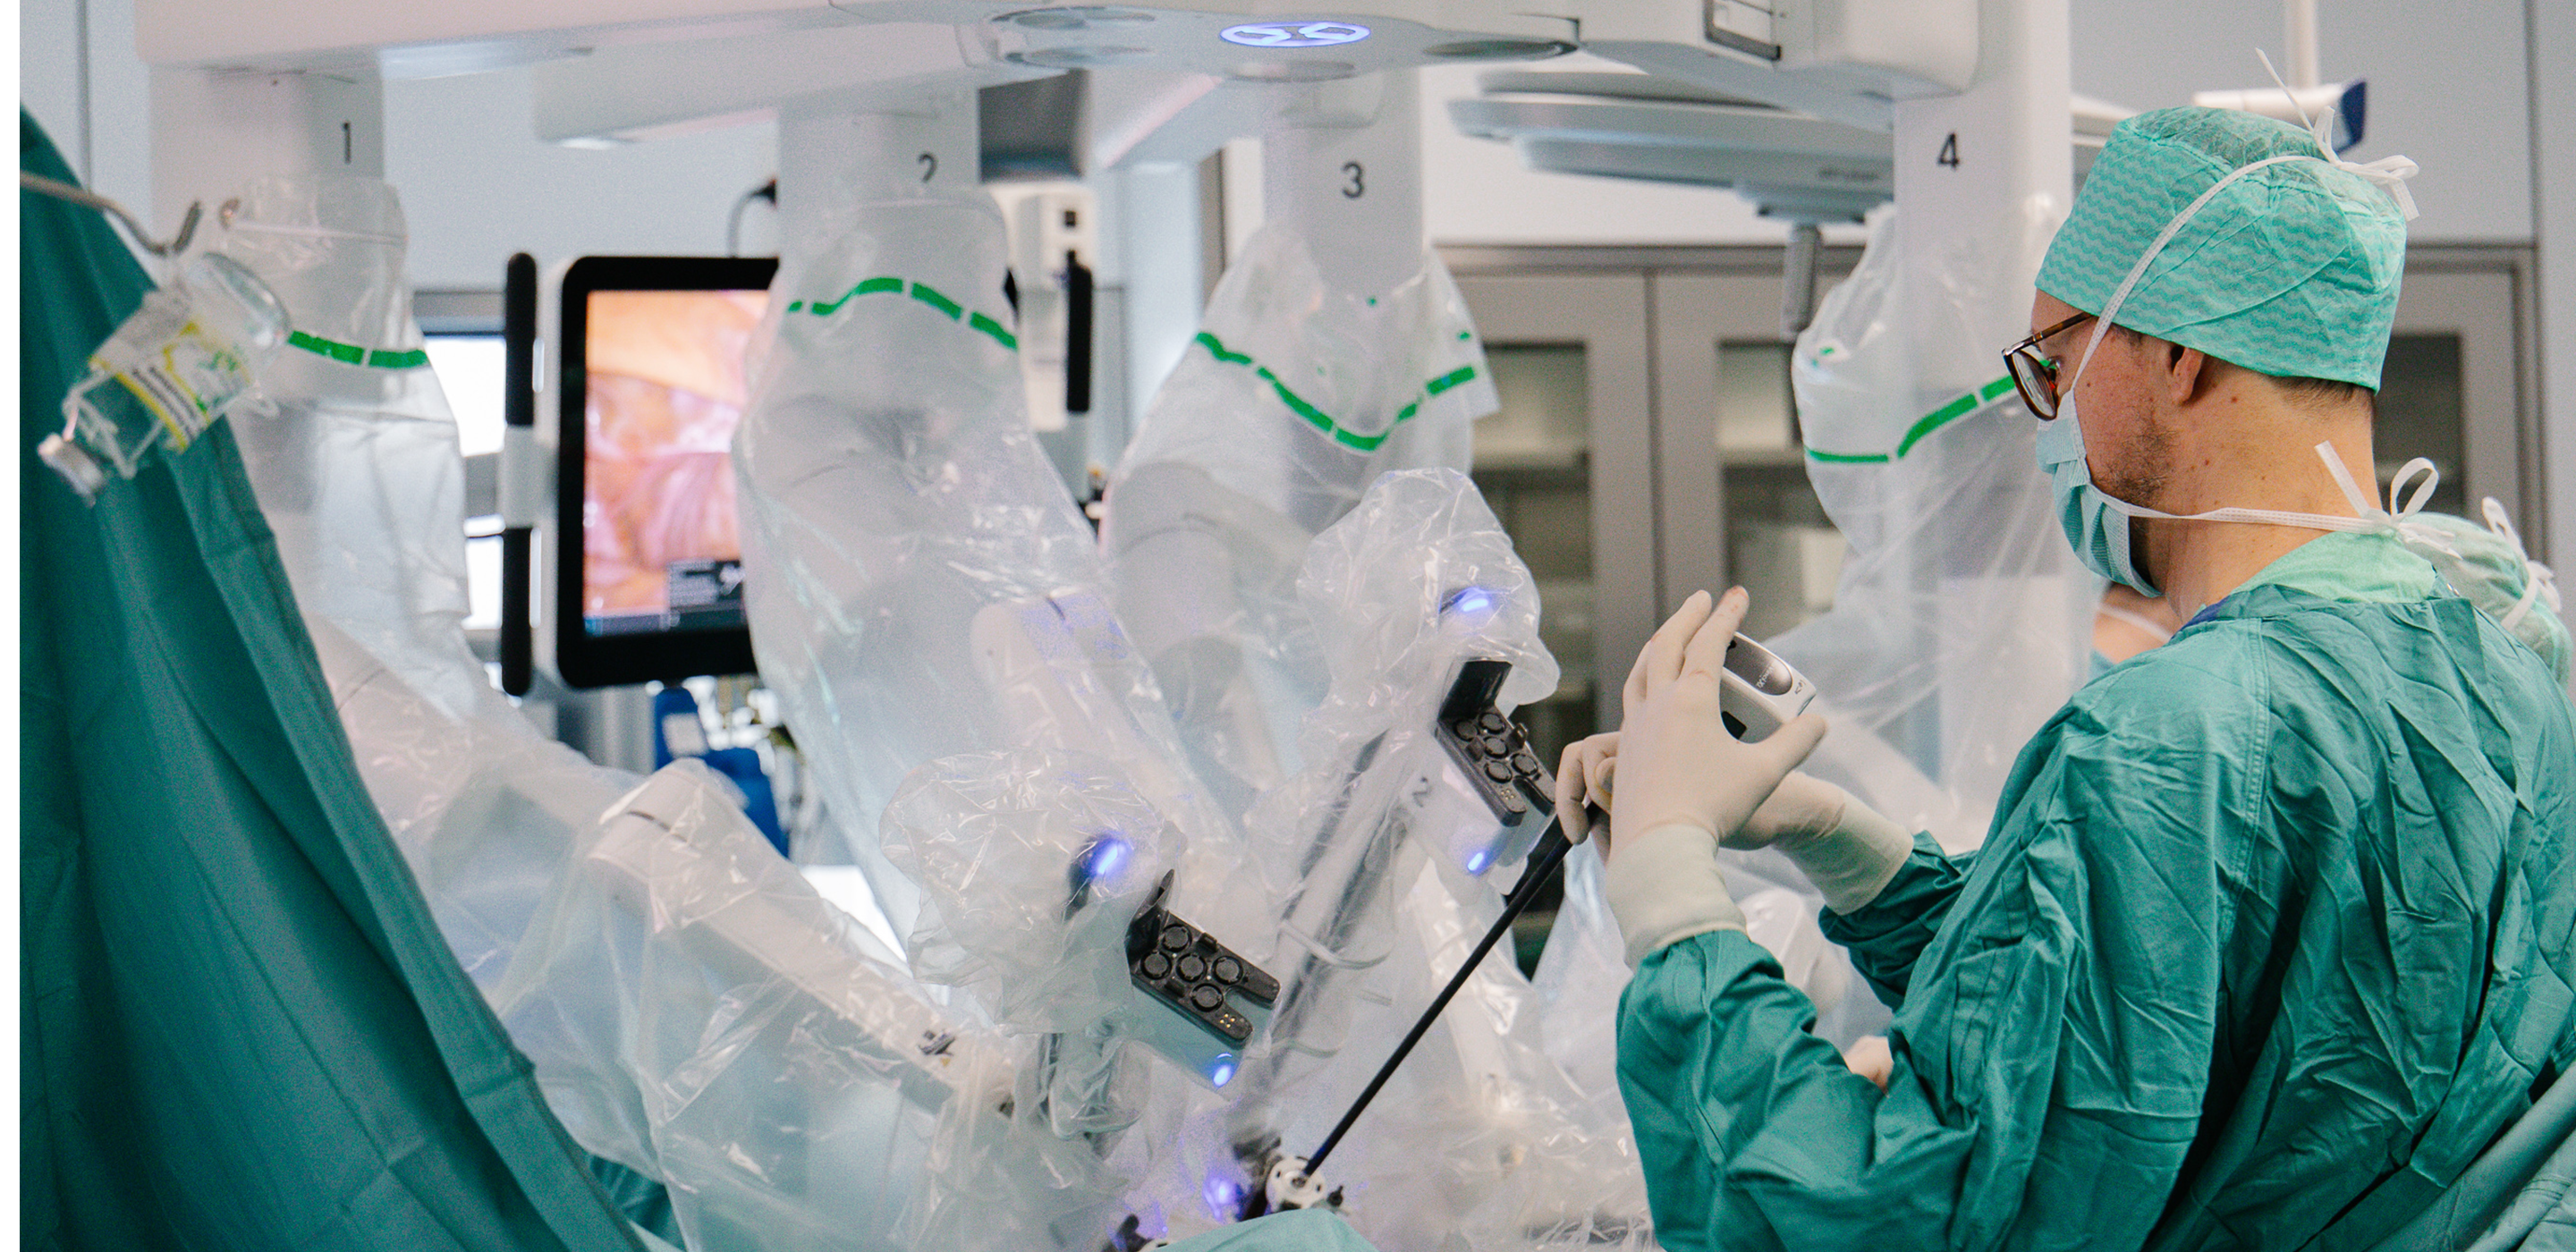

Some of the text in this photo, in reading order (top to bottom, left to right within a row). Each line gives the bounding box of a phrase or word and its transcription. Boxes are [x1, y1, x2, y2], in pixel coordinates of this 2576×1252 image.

[343, 122, 352, 164] 1
[1937, 132, 1960, 170] 4
[1342, 162, 1364, 199] 3
